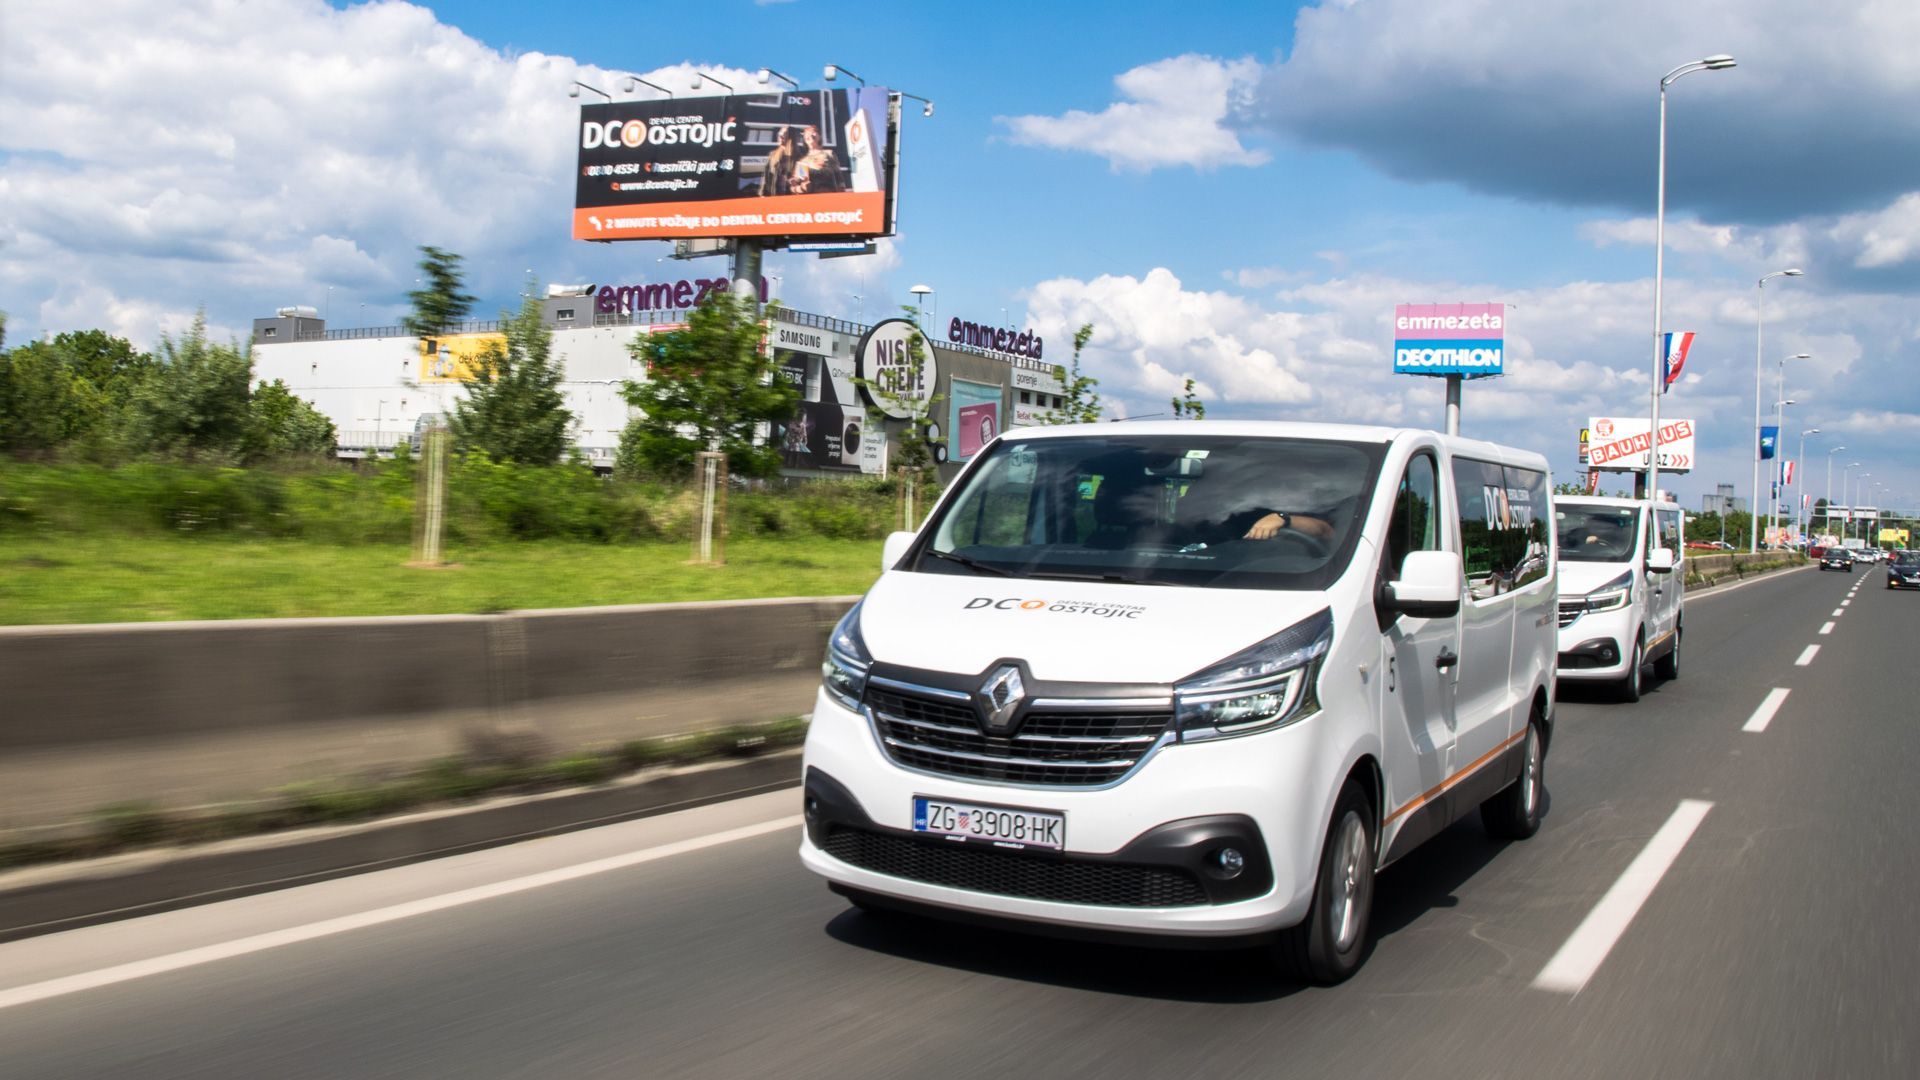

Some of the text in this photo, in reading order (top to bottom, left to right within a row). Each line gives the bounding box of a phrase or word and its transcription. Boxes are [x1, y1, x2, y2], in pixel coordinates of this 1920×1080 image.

[648, 116, 737, 148] OSTOJIĆ
[696, 161, 718, 175] put
[605, 219, 613, 229] 2
[614, 218, 657, 228] MINUTE
[702, 217, 719, 227] DO
[721, 215, 765, 226] DENTAL
[766, 213, 813, 224] CENTRA
[814, 209, 863, 225] OSTOJIĆ
[597, 276, 769, 313] emmeze
[1397, 312, 1502, 330] emmezeta
[780, 329, 821, 349] SAMSUNG
[949, 317, 1042, 360] emmezeta
[1396, 348, 1501, 367] DECATHLON
[1016, 373, 1038, 387] gorenje
[1643, 452, 1668, 466] UAZ
[1389, 656, 1396, 693] 5
[929, 804, 956, 831] ZG
